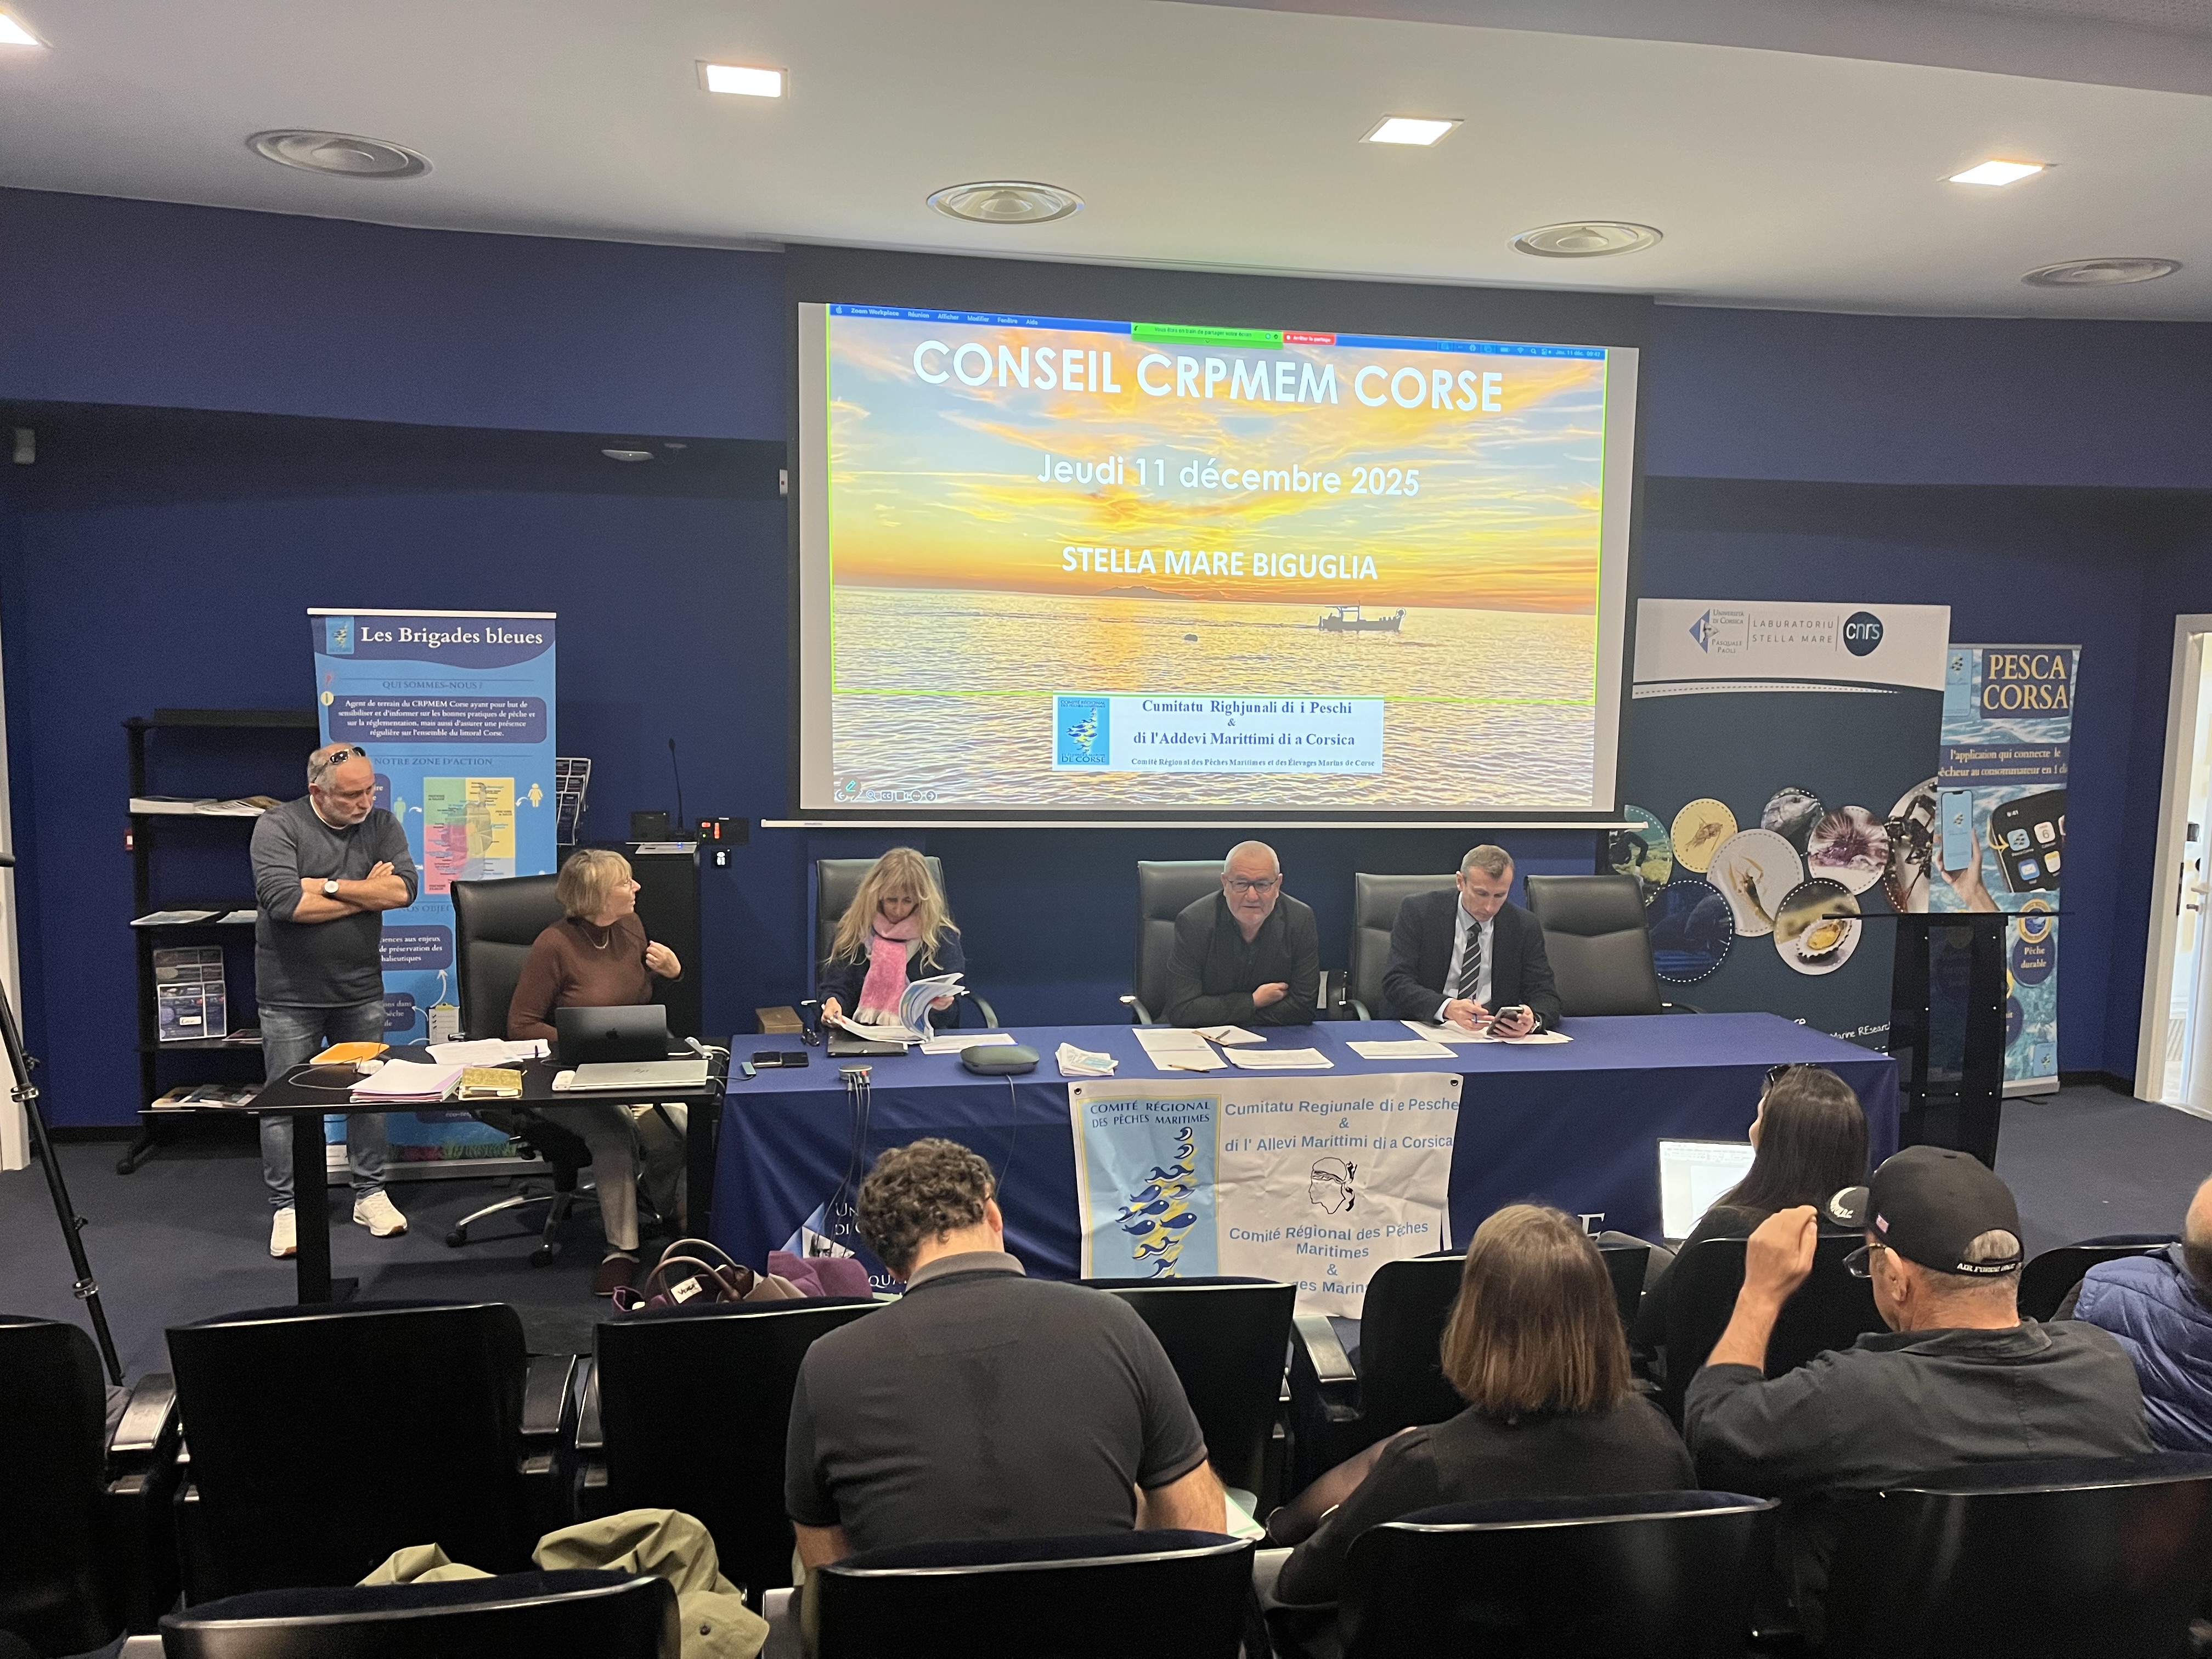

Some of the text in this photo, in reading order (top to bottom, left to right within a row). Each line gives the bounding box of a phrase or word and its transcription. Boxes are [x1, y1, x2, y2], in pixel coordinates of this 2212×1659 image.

[869, 308, 899, 317] Workplace
[913, 340, 1502, 412] CONSEIL CRPMEM CORSE
[1037, 454, 1420, 496] Jeudi 11 décembre 2025
[1062, 546, 1378, 580] STELLA MARE BIGUGLIA
[1753, 619, 1833, 629] LABURATORIU
[1846, 623, 1880, 640] cnrs
[360, 627, 543, 648] Les Brigades bleues
[1752, 634, 1833, 644] STELLA MARE
[1989, 654, 2067, 680] PESCA
[383, 681, 404, 690] QUI
[1983, 684, 2069, 710] CORSA
[345, 700, 365, 708] Agent
[1142, 699, 1352, 716] Cumitatu Righjunali di i Peschi
[467, 710, 497, 719] pratiques
[508, 710, 527, 719] pêche
[498, 720, 527, 729] présence
[1227, 718, 1235, 726] &
[370, 729, 400, 737] régulière
[1133, 732, 1355, 745] di l'Addevi Marittimi di a Corsica
[1950, 749, 1996, 763] l'application
[1999, 749, 2012, 761] qui
[2054, 747, 2061, 758] le
[443, 758, 493, 766] D'ACTION
[1159, 758, 1190, 767] Régional
[1939, 766, 1970, 777] êcheur
[1981, 767, 2040, 776] consommateur
[422, 905, 452, 913] OBJEC
[389, 945, 430, 954] préservation
[2024, 945, 2045, 955] Pêche
[381, 955, 421, 963] halieutiques
[2021, 958, 2047, 968] durable
[1091, 1100, 1210, 1114] COMITÉ RÉGIONAL
[1225, 1097, 1459, 1116] Cumitatu Regiunale di e Pesche
[1092, 1114, 1210, 1128] DES PÊCHES MARITIMES
[1339, 1117, 1350, 1128] &
[1225, 1138, 1239, 1152] di
[1256, 1135, 1296, 1152] Allevi
[1301, 1135, 1368, 1148] Marittimi
[1373, 1137, 1386, 1150] di
[1390, 1139, 1398, 1149] a
[1402, 1135, 1453, 1149] Corsica
[1229, 1227, 1281, 1243] Comité
[1286, 1224, 1351, 1241] Régional
[1356, 1227, 1381, 1241] des
[1296, 1242, 1369, 1259] Maritimes
[1327, 1263, 1338, 1276] &
